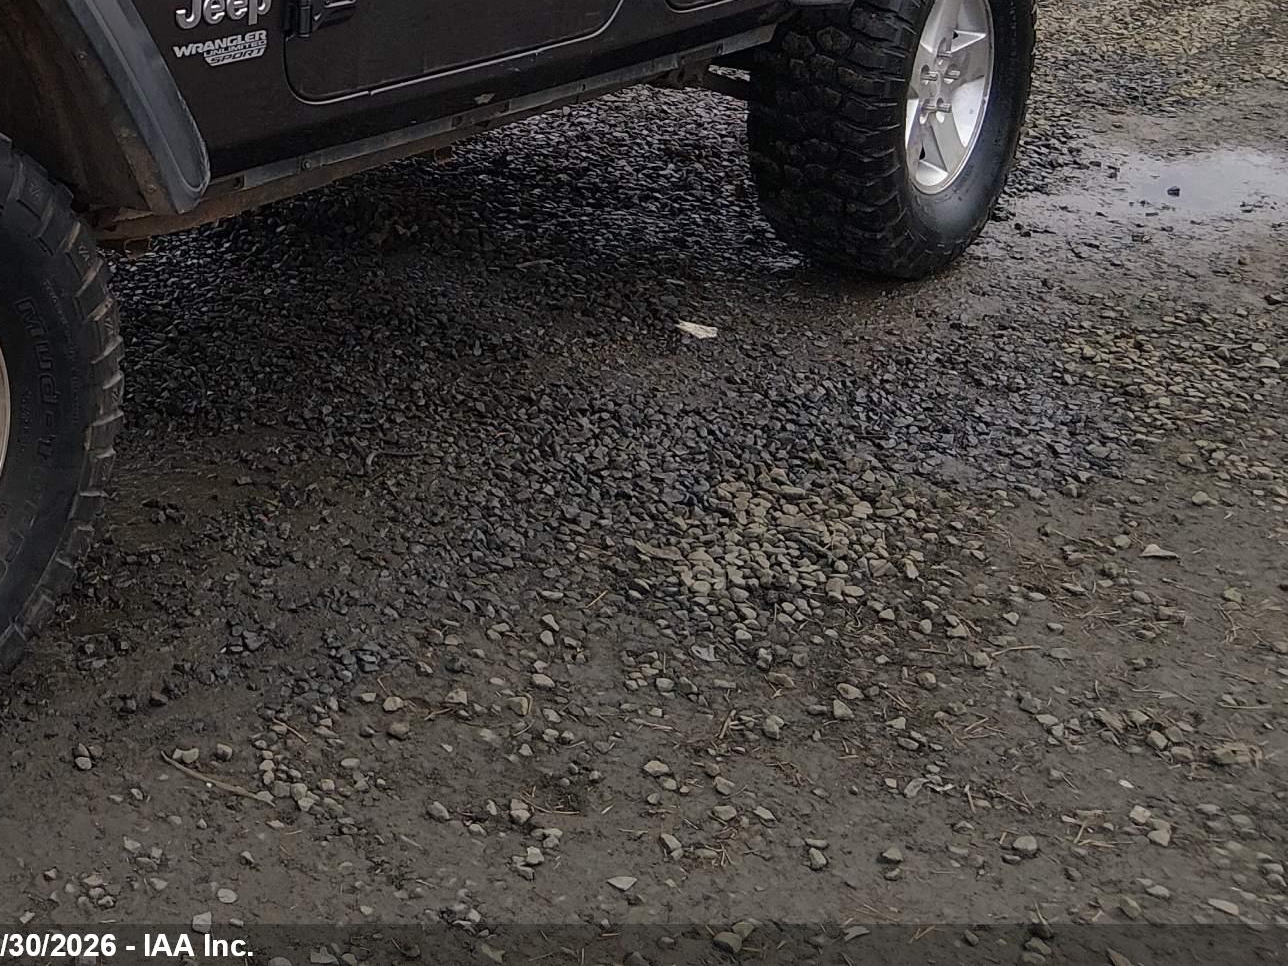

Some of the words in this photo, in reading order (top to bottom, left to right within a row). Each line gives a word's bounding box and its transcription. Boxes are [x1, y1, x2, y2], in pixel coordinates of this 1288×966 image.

[173, 29, 267, 58] WRANGLER
[203, 40, 267, 58] UNLIMITED
[209, 47, 265, 65] SPORT
